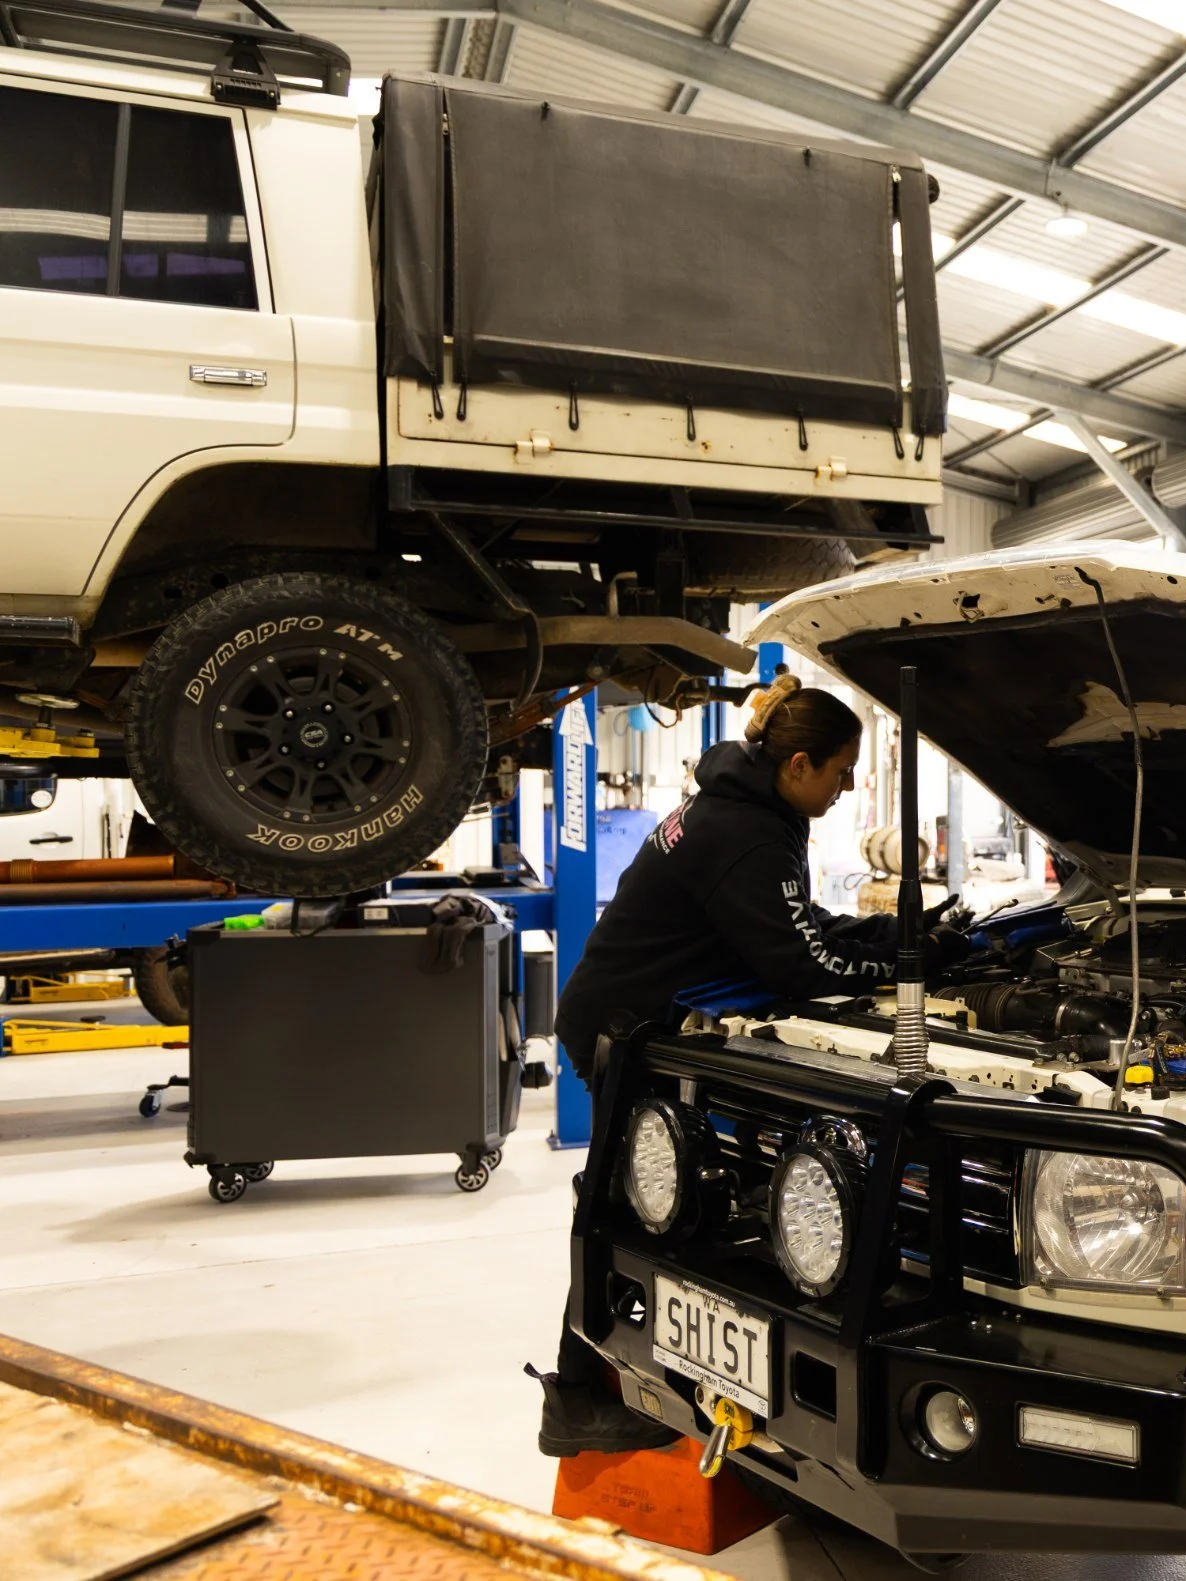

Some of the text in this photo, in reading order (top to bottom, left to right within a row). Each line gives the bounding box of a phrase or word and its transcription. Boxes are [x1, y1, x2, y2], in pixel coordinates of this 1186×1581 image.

[185, 615, 324, 705] Dynapro
[781, 880, 896, 979] AUTOMOTIVE
[682, 1279, 736, 1308] rockinghamtoyota.com.au
[702, 1295, 721, 1315] WA
[667, 1296, 758, 1384] SHIST
[678, 1359, 741, 1399] Rockingham Toyota
